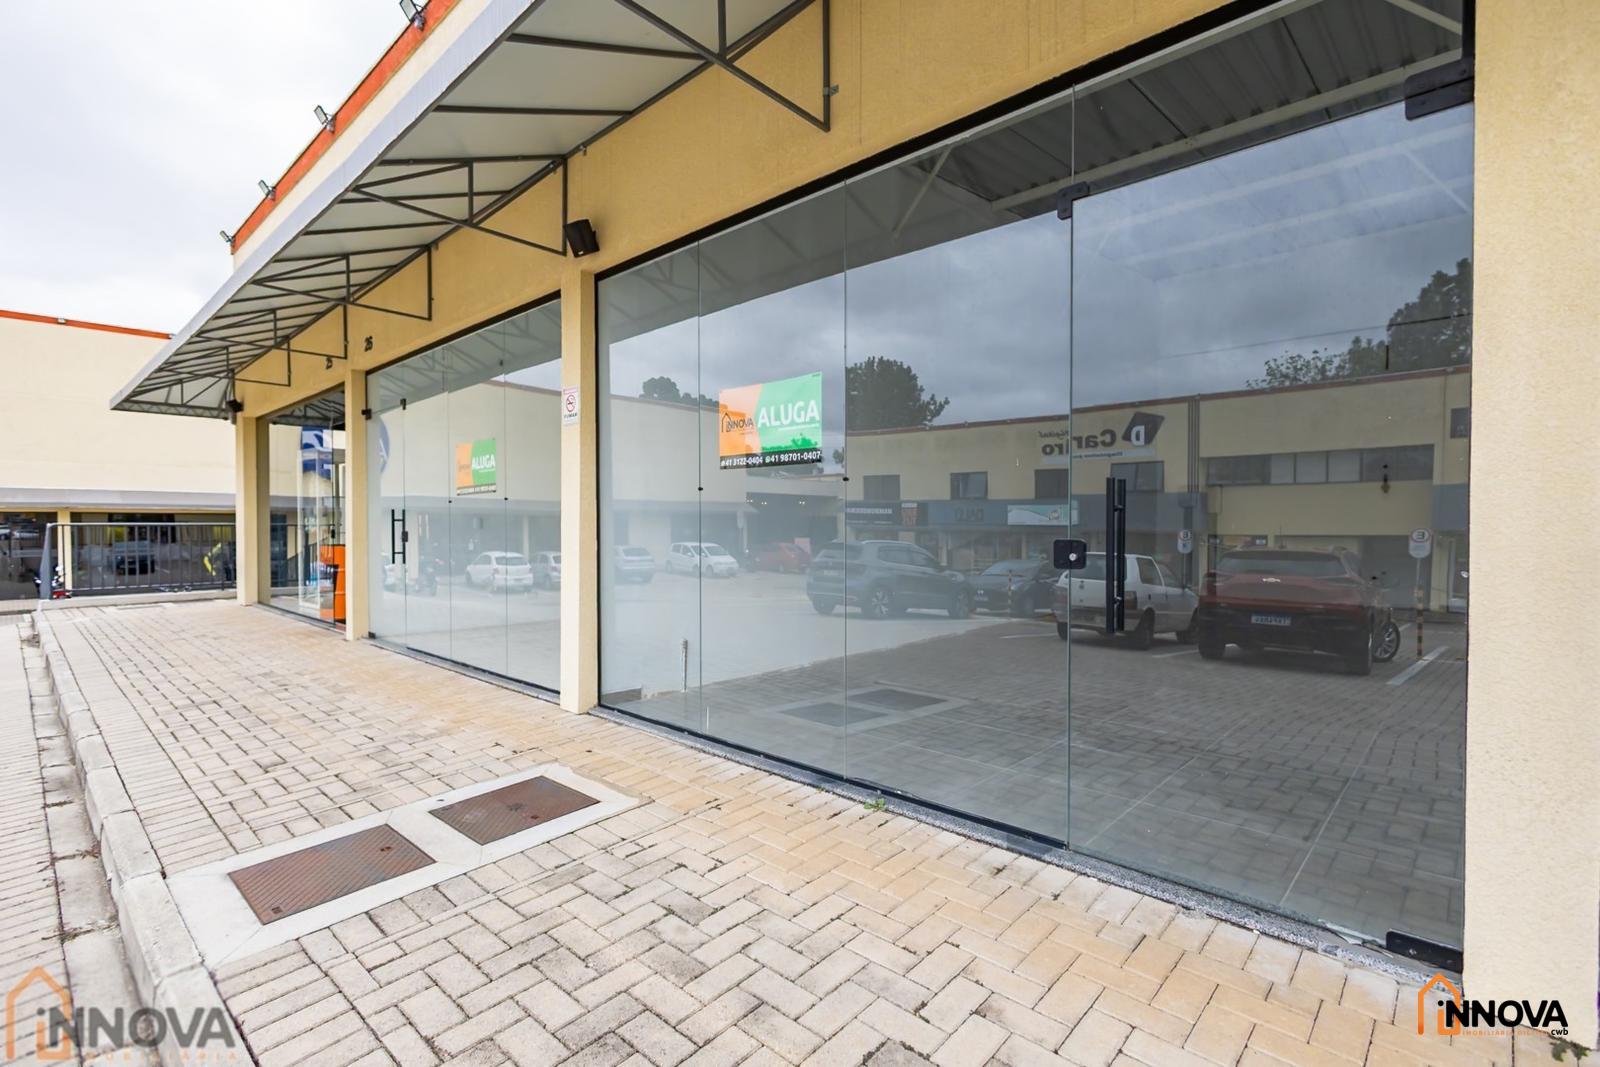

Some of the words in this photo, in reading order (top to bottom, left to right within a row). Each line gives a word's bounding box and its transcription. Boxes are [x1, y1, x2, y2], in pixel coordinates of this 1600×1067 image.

[757, 399, 820, 428] ALUGA
[472, 453, 496, 469] ALUGA
[769, 455, 779, 464] 41
[780, 451, 821, 463] 98701-0407
